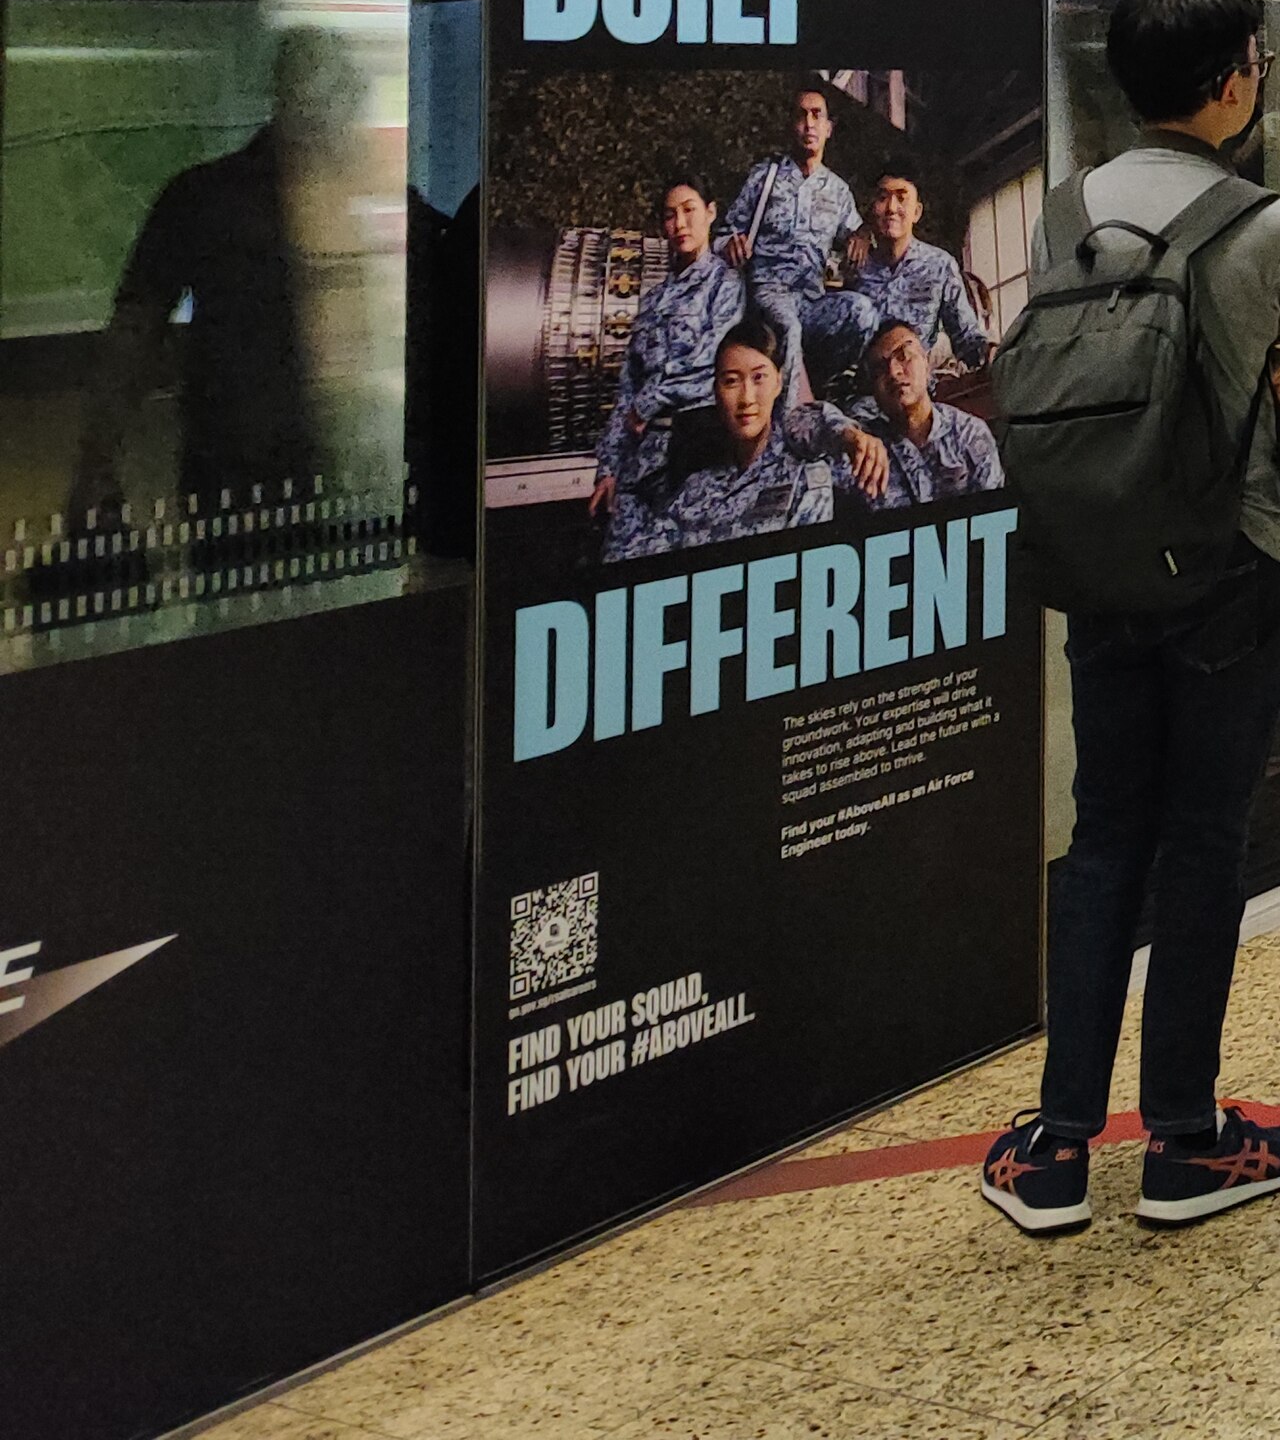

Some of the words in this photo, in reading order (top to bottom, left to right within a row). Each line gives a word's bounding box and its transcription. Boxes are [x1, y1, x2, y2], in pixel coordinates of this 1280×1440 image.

[513, 507, 1019, 763] DIFFERENT
[781, 740, 844, 769] innovation,
[845, 726, 894, 750] adapting
[894, 717, 916, 734] and
[917, 706, 958, 729] building
[959, 698, 984, 716] what
[984, 695, 994, 710] it
[782, 719, 852, 753] groundwork.
[855, 712, 881, 729] Your
[882, 698, 932, 722] expertise
[933, 691, 950, 706] will
[951, 684, 978, 702] drive
[783, 715, 806, 731] The
[807, 709, 836, 724] skies
[838, 701, 860, 718] rely
[861, 696, 876, 710] on
[877, 690, 896, 706] the
[897, 677, 942, 701] strength
[943, 671, 955, 687] of
[955, 668, 979, 687] your
[781, 767, 815, 787] takes
[816, 762, 828, 776] to
[829, 755, 852, 772] rise
[853, 745, 890, 766] above.
[891, 735, 918, 754] Lead
[919, 729, 938, 745] the
[938, 721, 969, 739] future
[970, 714, 992, 731] with
[992, 712, 1001, 723] a
[781, 782, 818, 805] squad
[819, 763, 879, 793] assembled
[880, 761, 892, 774] to
[893, 750, 927, 770] thrive.
[780, 821, 808, 842] Find
[808, 813, 837, 835] your
[837, 790, 897, 822] #AboveAll
[896, 789, 911, 803] as
[911, 783, 927, 798] an
[926, 777, 944, 794] Air
[944, 768, 976, 790] Force
[780, 831, 835, 860] Engineer
[834, 819, 873, 842] today.
[507, 1062, 562, 1117] FIND
[566, 1039, 626, 1092] YOUR
[629, 992, 757, 1068] #ABOVEALL.
[508, 1022, 562, 1075] FIND
[566, 999, 627, 1052] YOUR
[630, 971, 710, 1028] SQUAD,
